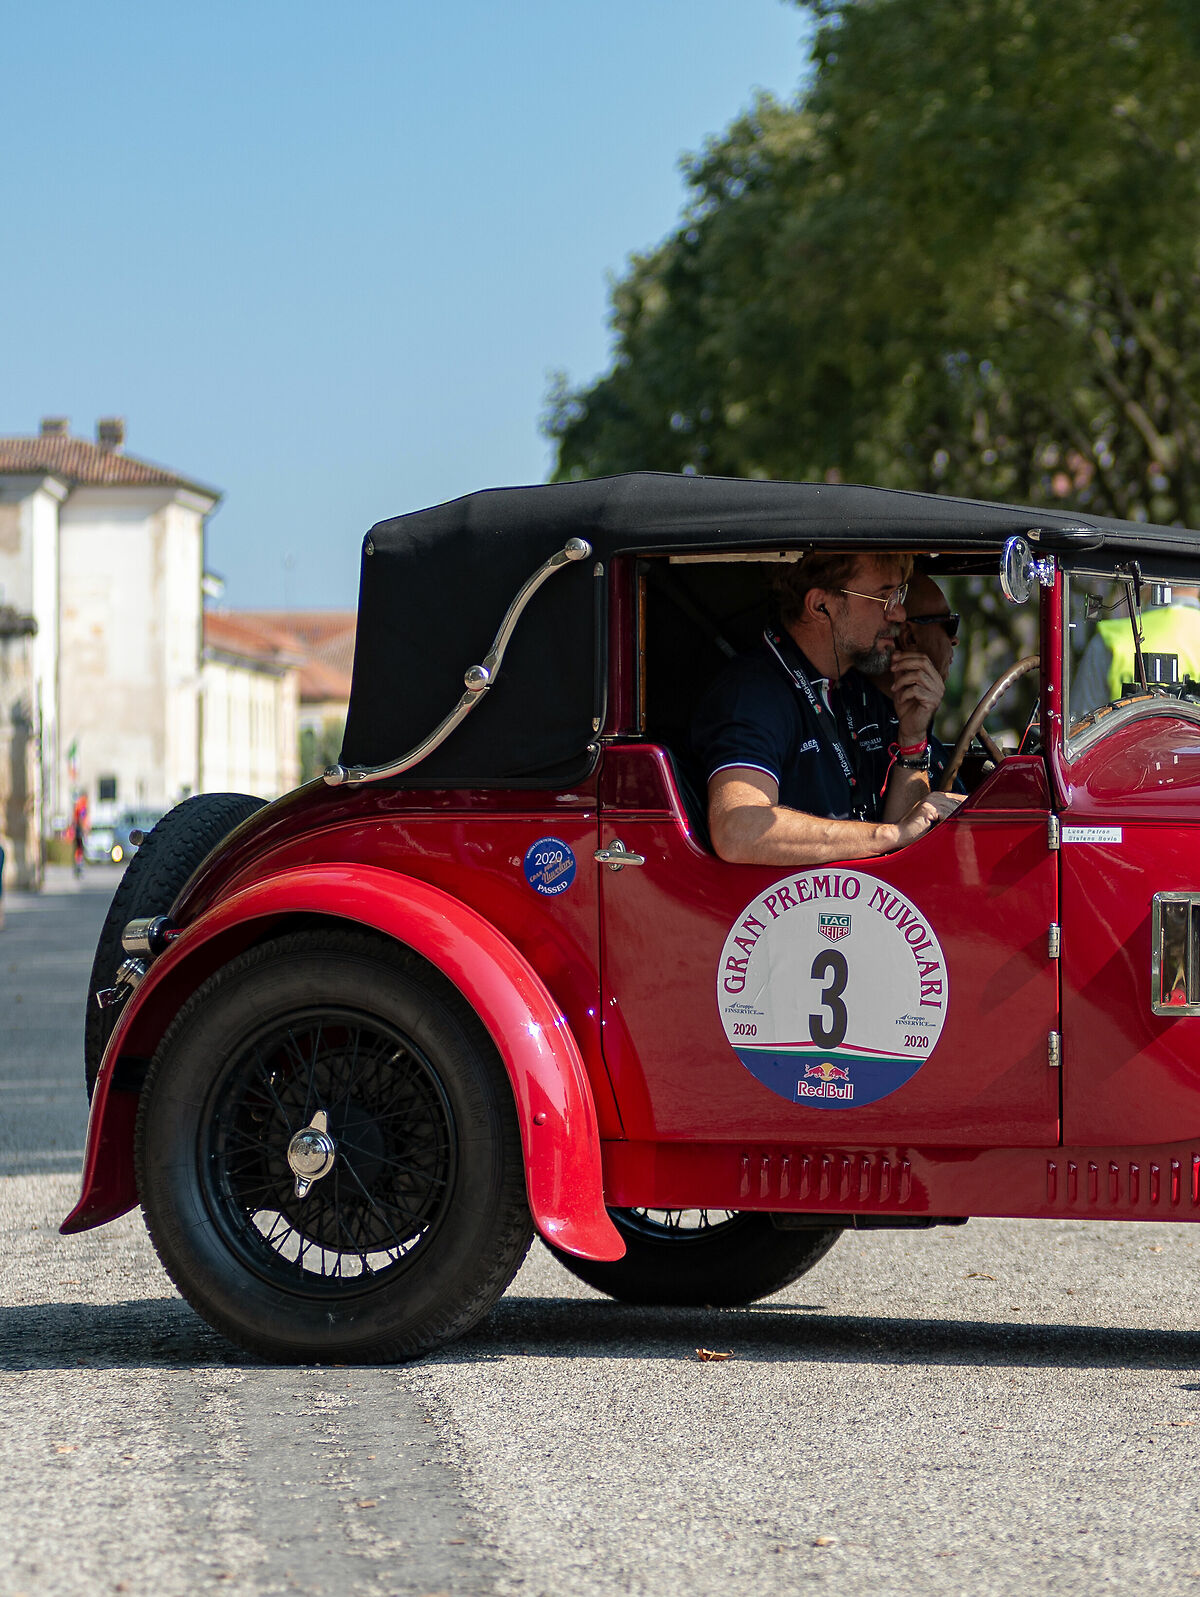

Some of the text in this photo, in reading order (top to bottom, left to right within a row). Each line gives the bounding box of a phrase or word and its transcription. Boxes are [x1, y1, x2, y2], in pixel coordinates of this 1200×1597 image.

[535, 850, 563, 866] 2020
[537, 880, 568, 894] PASSED
[822, 916, 848, 926] TAG
[820, 926, 849, 939] HEUER
[723, 874, 942, 1009] GRAN PREMIO NUVOLARI
[808, 948, 849, 1050] 3
[733, 1022, 758, 1036] 2020
[904, 1034, 929, 1048] 2020
[798, 1080, 854, 1100] Red Bull
